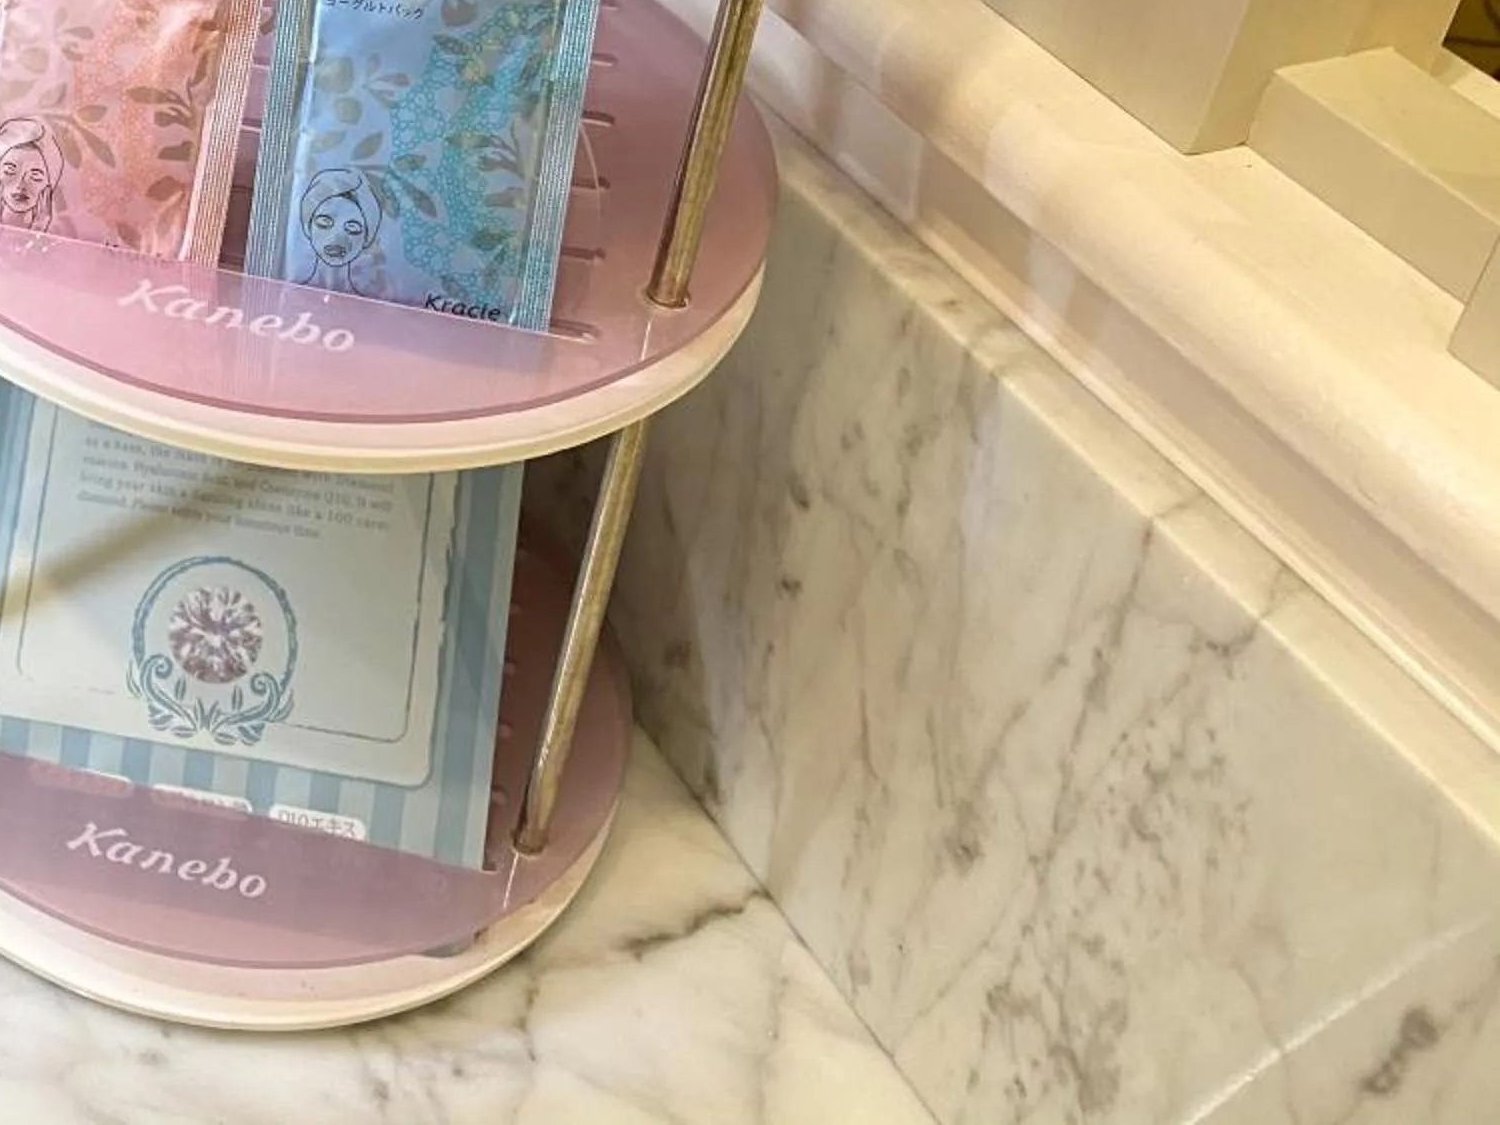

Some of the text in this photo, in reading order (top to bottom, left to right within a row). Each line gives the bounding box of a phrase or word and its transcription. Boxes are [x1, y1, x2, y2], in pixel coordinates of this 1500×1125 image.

[117, 278, 356, 352] Kanebo
[426, 293, 501, 322] Kracie
[66, 821, 268, 899] Kanebo
